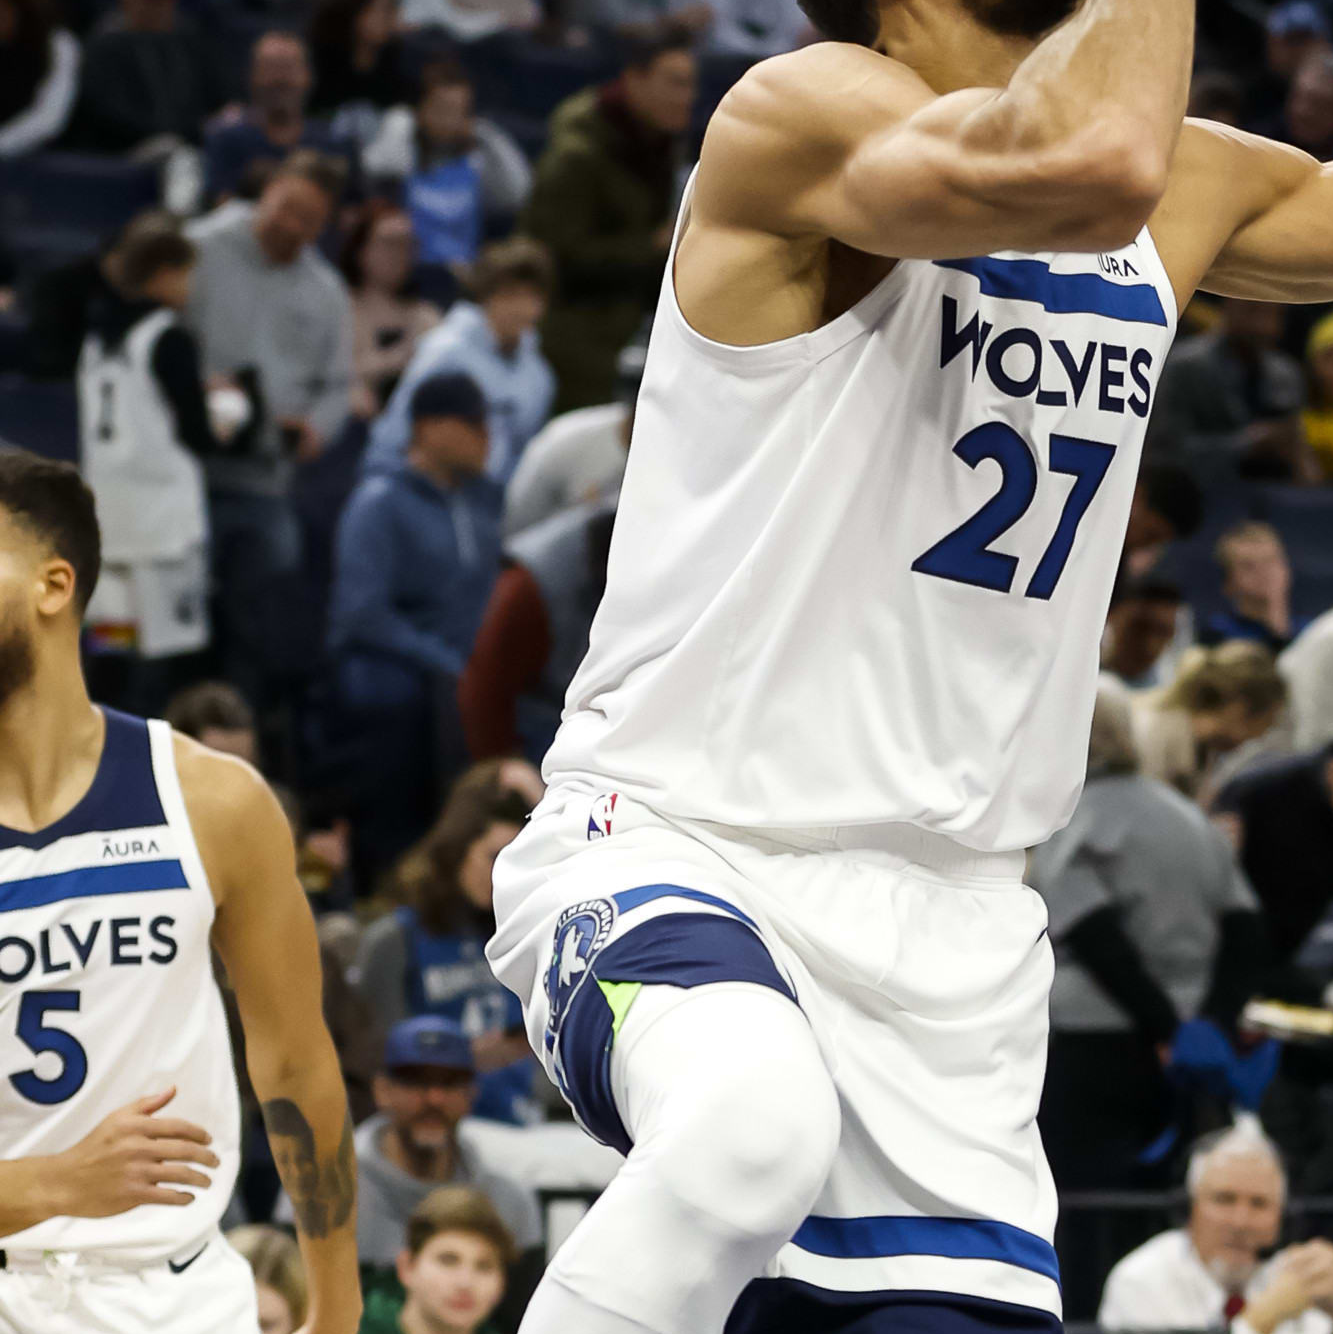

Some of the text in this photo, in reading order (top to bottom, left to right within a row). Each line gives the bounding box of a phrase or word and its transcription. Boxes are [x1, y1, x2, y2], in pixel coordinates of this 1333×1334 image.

[939, 293, 1154, 419] WOLVES
[910, 420, 1118, 601] 27
[8, 989, 88, 1106] 5
